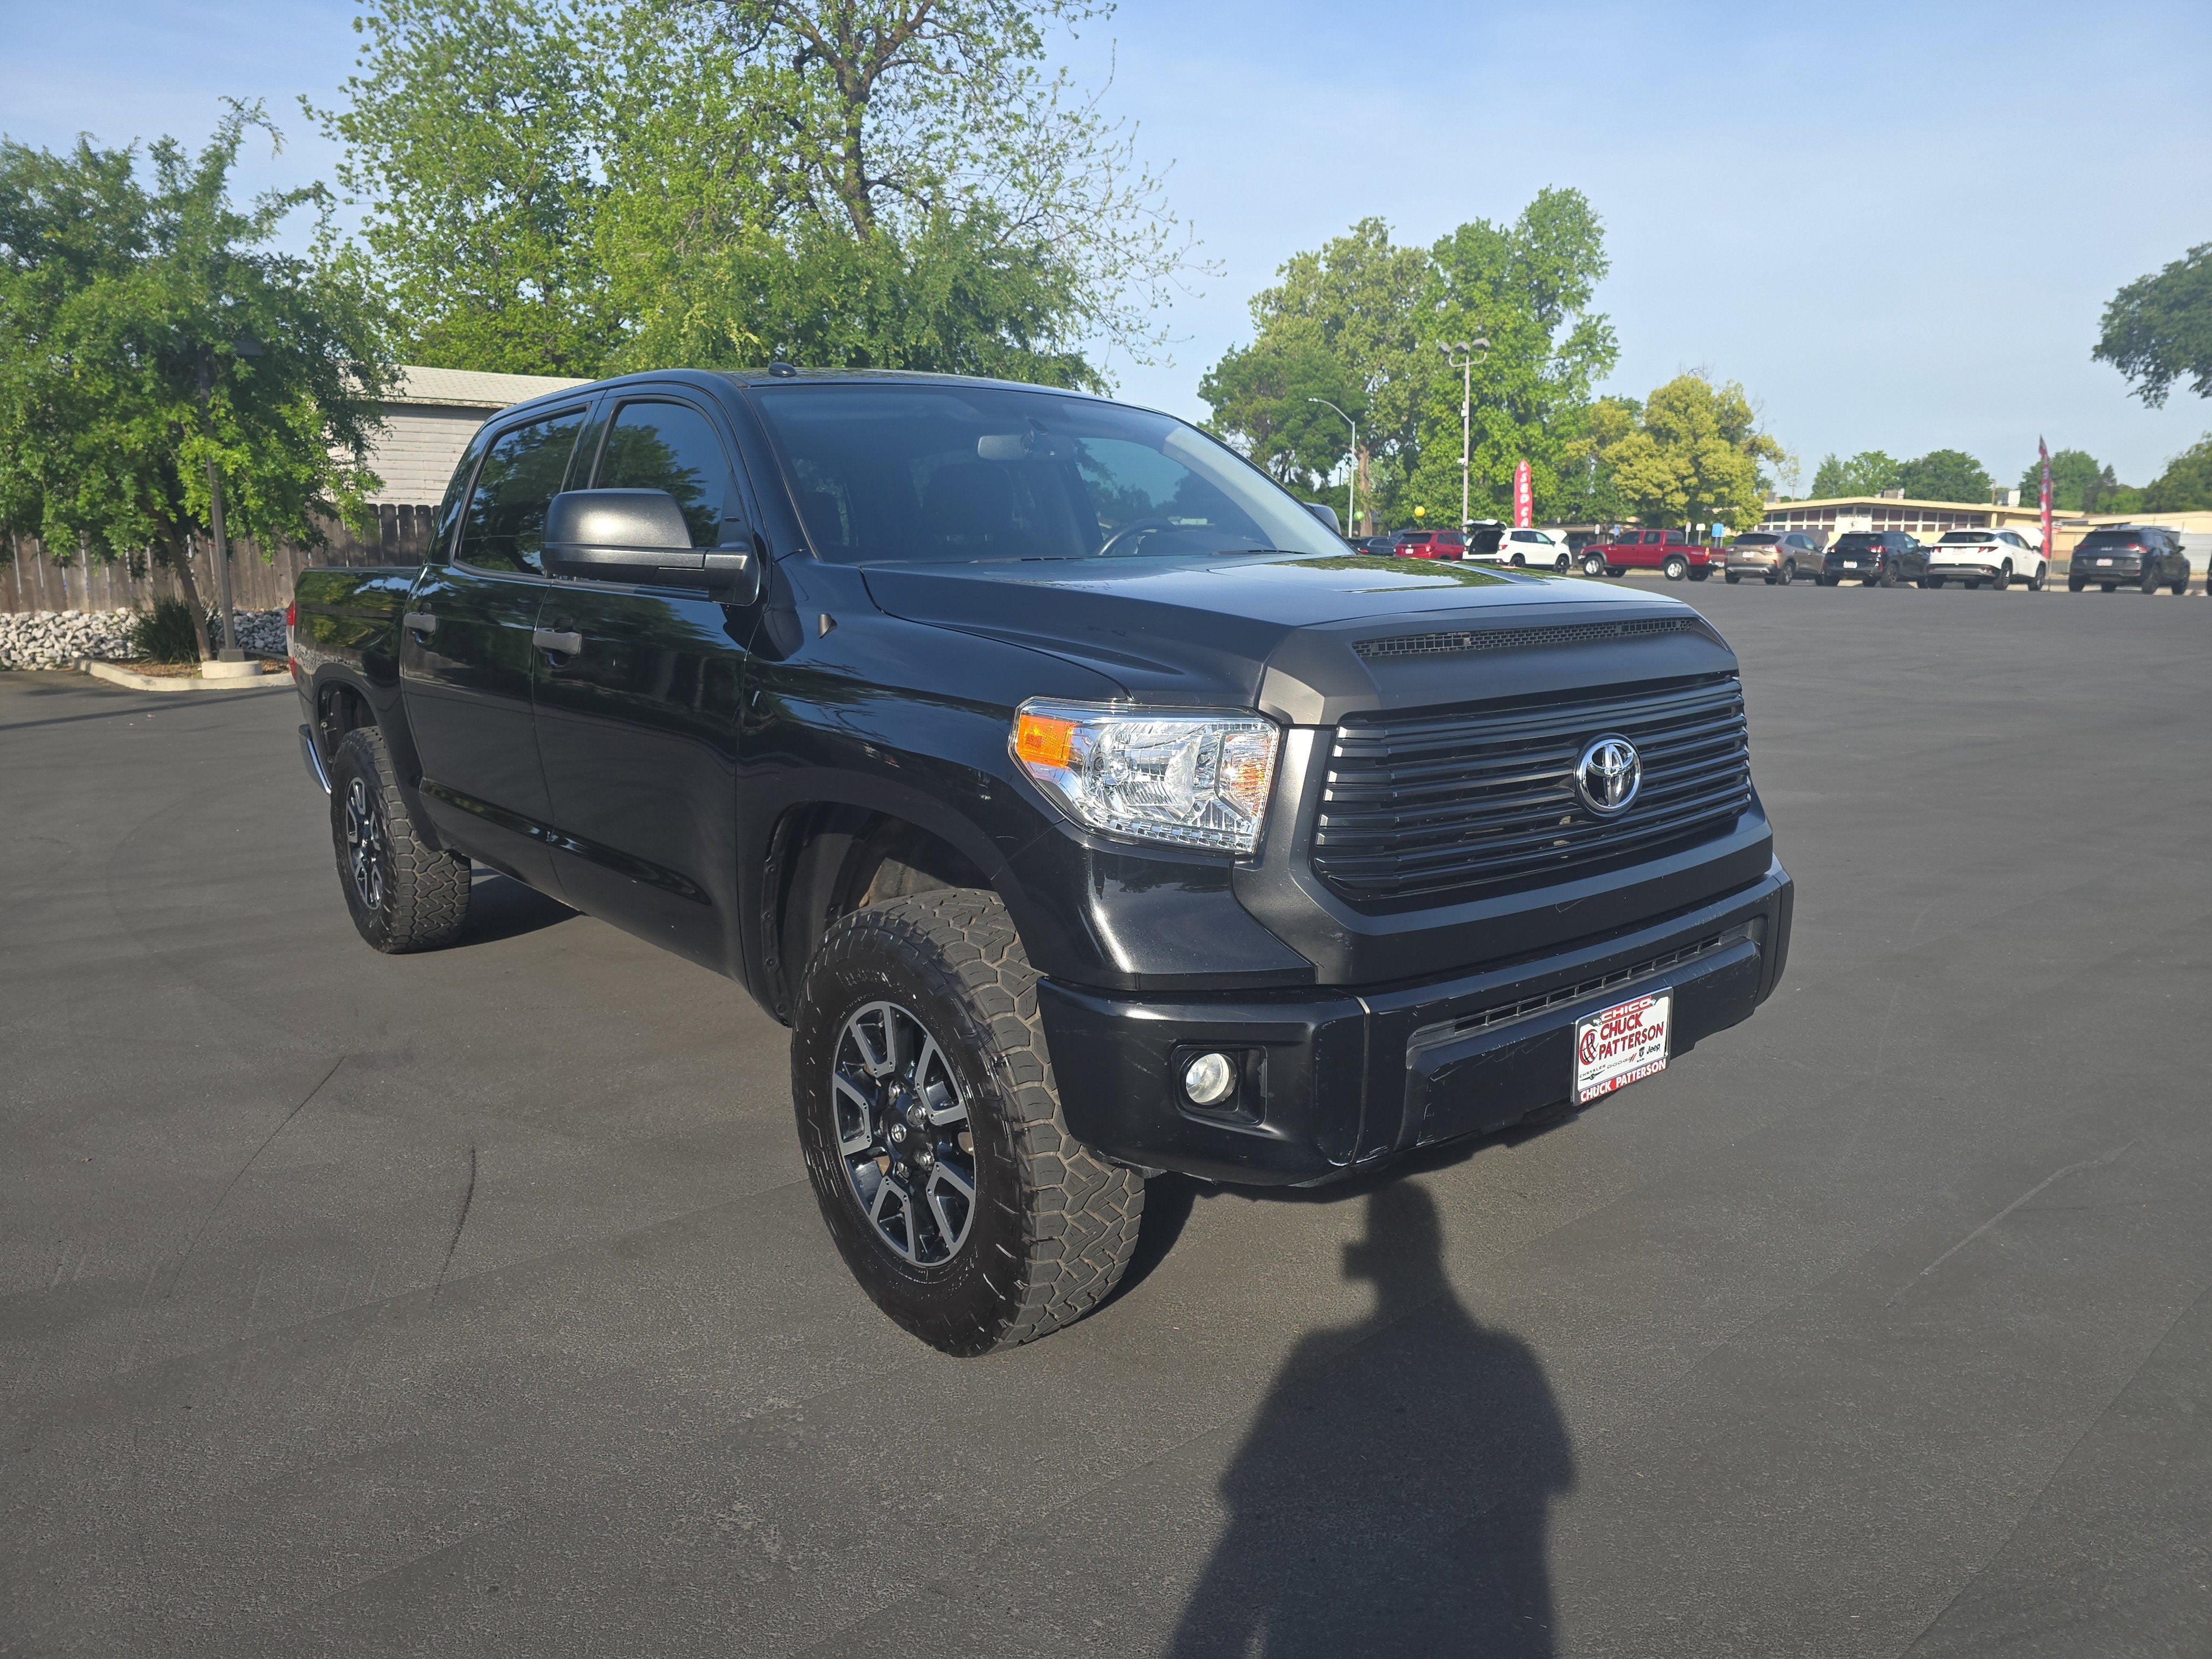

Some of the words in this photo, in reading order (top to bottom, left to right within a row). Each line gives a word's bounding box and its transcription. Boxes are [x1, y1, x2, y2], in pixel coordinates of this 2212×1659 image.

[1520, 506, 1529, 528] CA
[1600, 998, 1651, 1021] CHICO
[1599, 1022, 1664, 1060] PATTERSON
[1600, 1012, 1644, 1040] CHUCK
[1579, 1064, 1606, 1078] CHRYSLER
[1647, 1044, 1660, 1054] Jeep
[1580, 1081, 1612, 1102] CHUCK
[1616, 1059, 1666, 1088] PATTERSON
